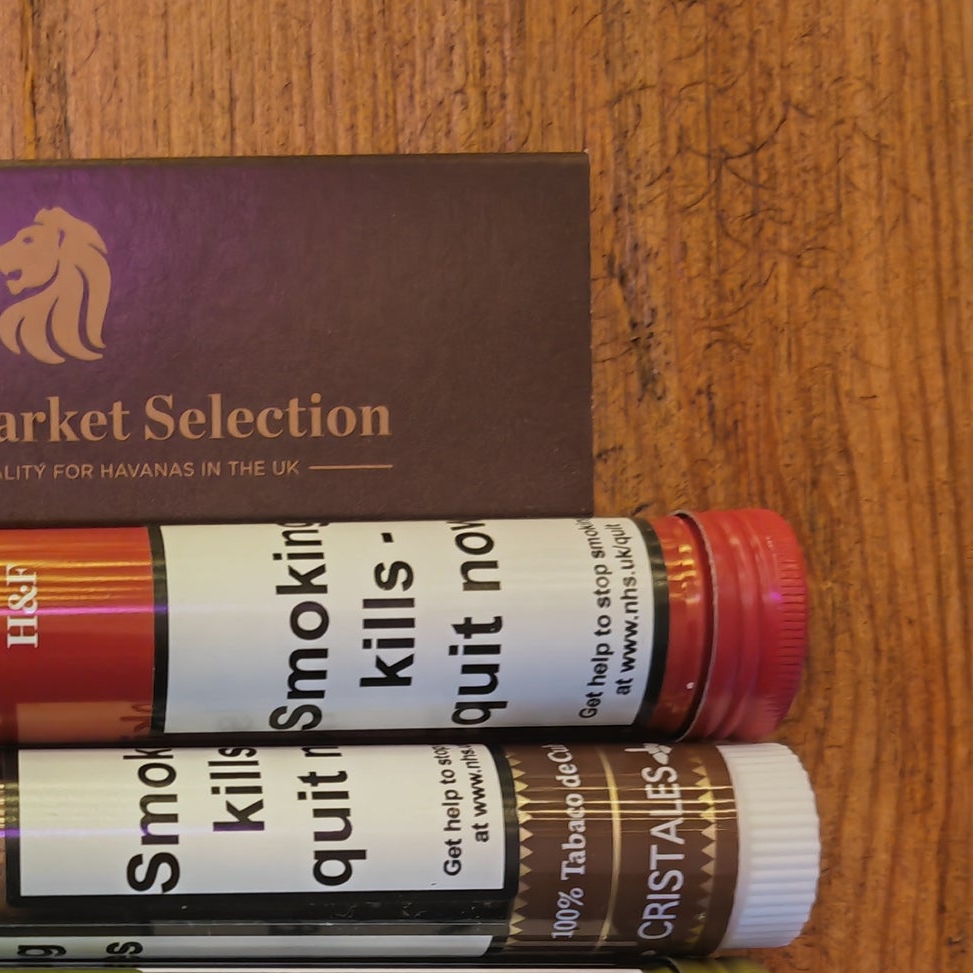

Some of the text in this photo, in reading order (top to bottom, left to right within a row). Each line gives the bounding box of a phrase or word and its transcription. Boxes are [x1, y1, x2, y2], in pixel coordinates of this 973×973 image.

[144, 392, 391, 442] Selection
[53, 463, 93, 480] FOR
[100, 461, 195, 480] HAVANAS
[201, 460, 221, 478] IN
[228, 460, 266, 477] THE
[272, 459, 300, 476] UK
[6, 563, 39, 649] H&F
[593, 564, 614, 609] stop
[604, 523, 640, 696] at www.nhs.uk/quit
[360, 560, 416, 688] kills
[594, 614, 613, 637] to
[449, 615, 508, 725] quit
[587, 643, 614, 687] help
[579, 691, 603, 719] Get
[207, 747, 266, 831] kills
[439, 768, 457, 785] to
[555, 763, 582, 788] de
[297, 771, 367, 887] quit
[441, 789, 465, 832] help
[471, 822, 490, 843] at
[443, 838, 463, 877] Get
[560, 793, 587, 881] Tabaco
[637, 766, 686, 940] CRISTALES
[551, 887, 585, 940] 100%
